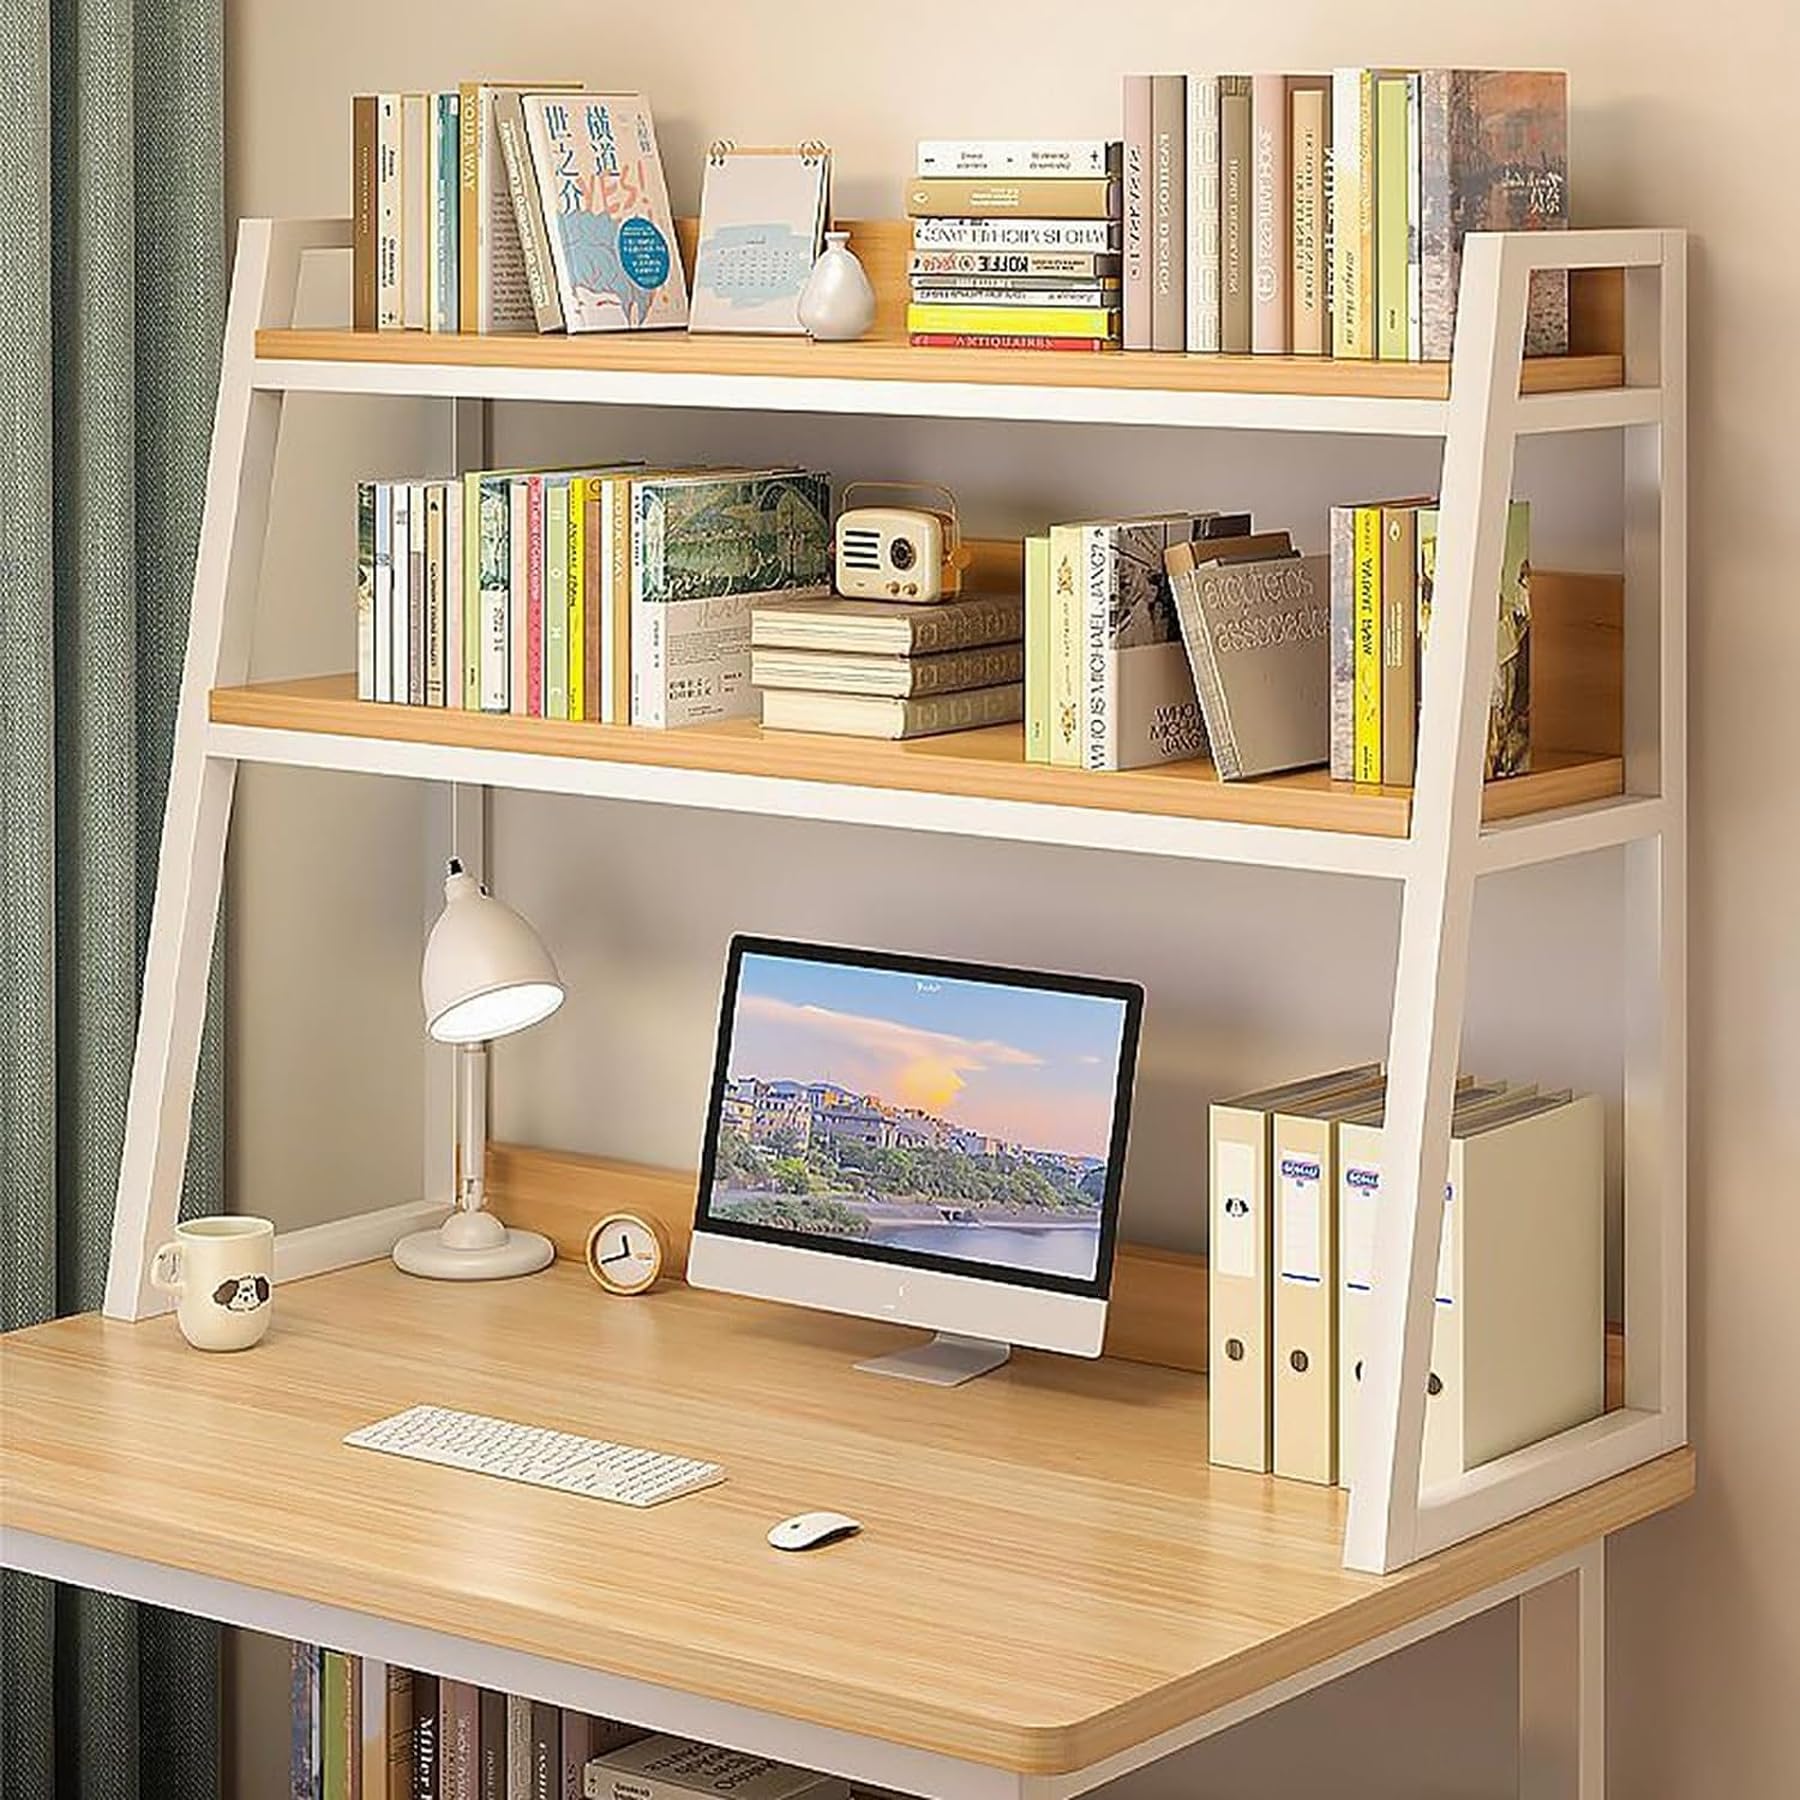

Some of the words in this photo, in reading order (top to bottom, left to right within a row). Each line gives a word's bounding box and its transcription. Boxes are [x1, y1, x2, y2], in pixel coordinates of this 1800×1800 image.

[463, 95, 476, 147] YOUR
[463, 153, 477, 191] WAY
[1089, 695, 1106, 715] IS
[1089, 718, 1106, 769] WHO
[420, 1716, 434, 1788] Miller
